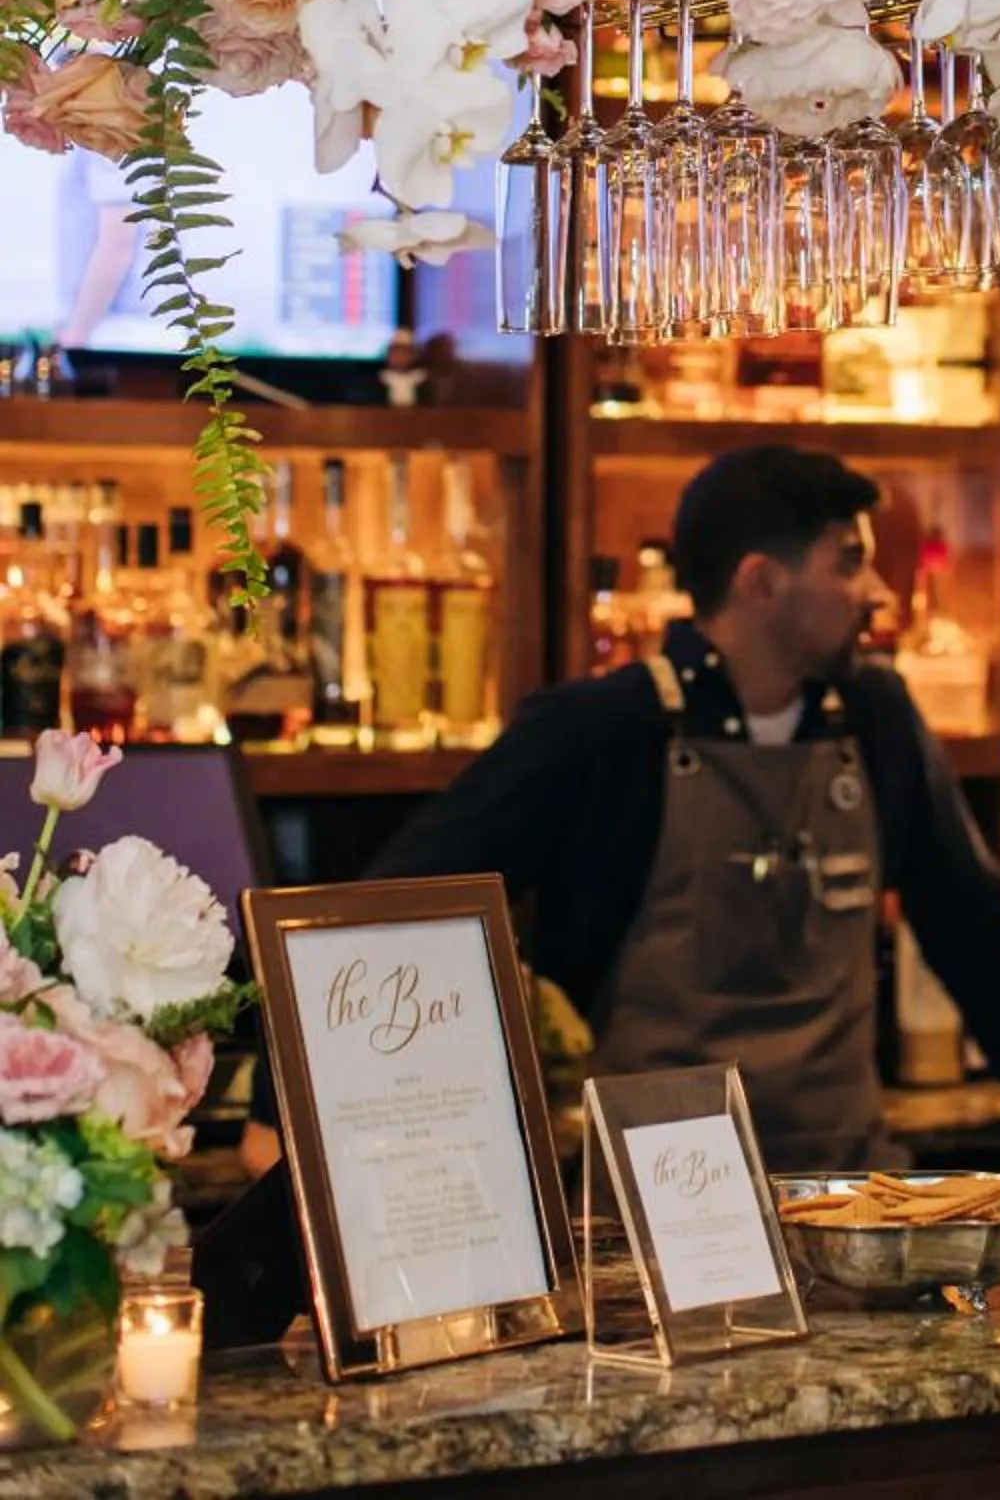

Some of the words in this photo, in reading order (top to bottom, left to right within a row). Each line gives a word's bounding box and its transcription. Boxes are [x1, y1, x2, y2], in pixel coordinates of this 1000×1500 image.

[326, 957, 371, 1031] the
[368, 963, 464, 1056] Bar
[653, 1147, 678, 1187] the
[678, 1148, 732, 1199] Bar
